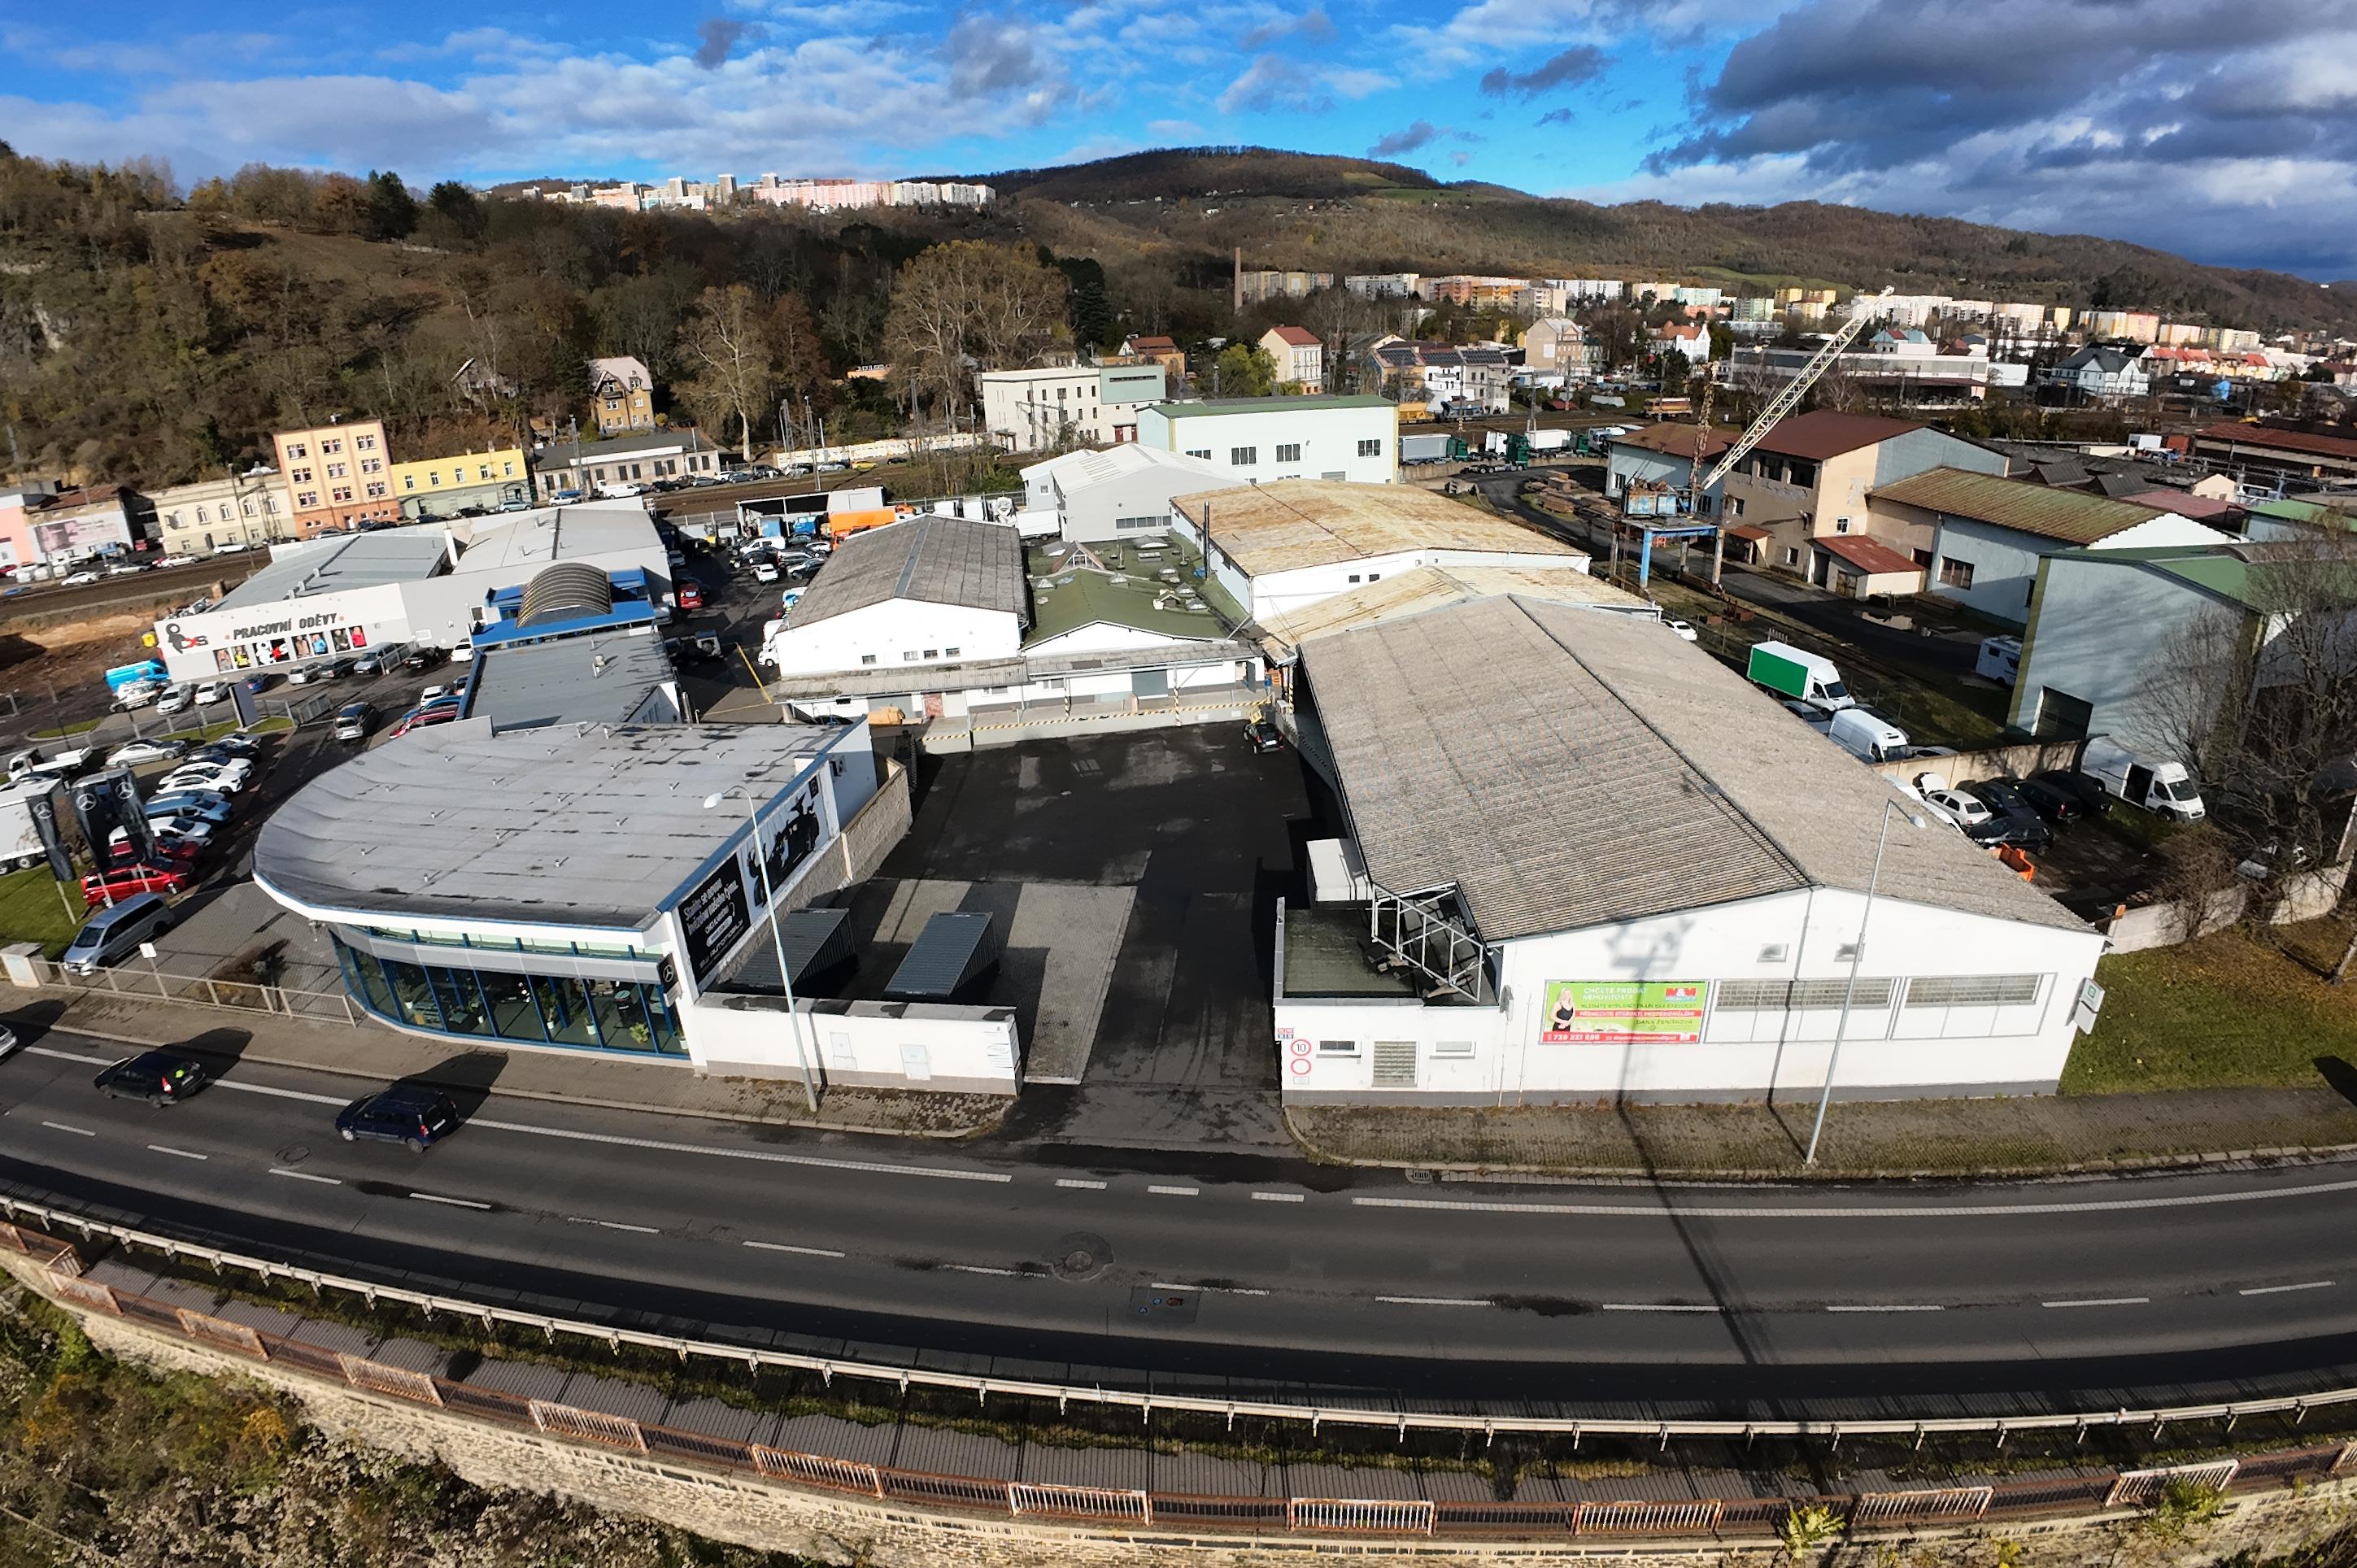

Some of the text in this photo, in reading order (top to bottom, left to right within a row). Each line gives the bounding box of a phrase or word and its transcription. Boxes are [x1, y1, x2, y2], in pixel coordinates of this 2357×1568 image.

[233, 612, 338, 640] PRACOVNÍ ODĚVY
[1296, 1043, 1306, 1052] 10
